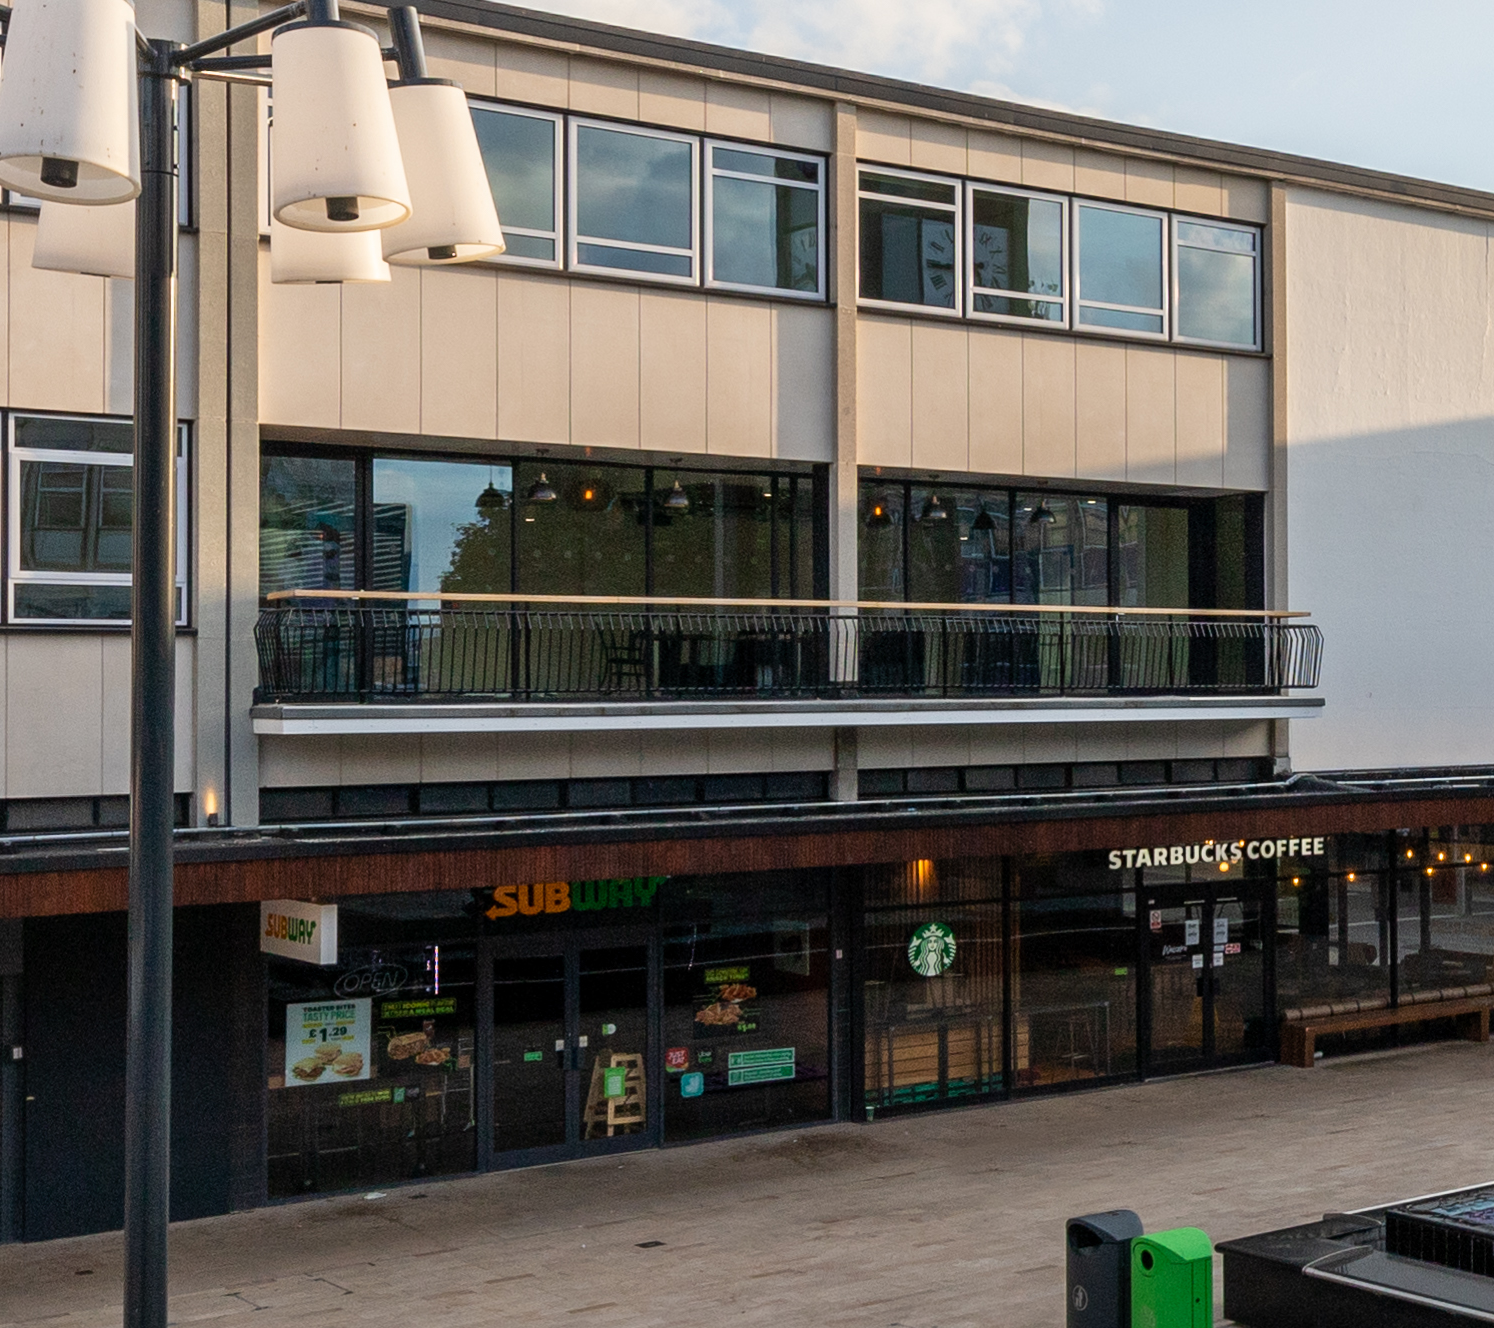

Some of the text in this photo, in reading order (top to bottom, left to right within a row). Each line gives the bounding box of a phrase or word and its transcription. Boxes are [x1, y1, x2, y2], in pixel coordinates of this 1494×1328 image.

[1108, 837, 1324, 870] STARBUCKS COFFEE
[485, 876, 668, 921] SUBWAY
[265, 913, 317, 945] SUBWAY
[344, 972, 399, 993] OPEN
[303, 1010, 355, 1022] TASTY PRICE
